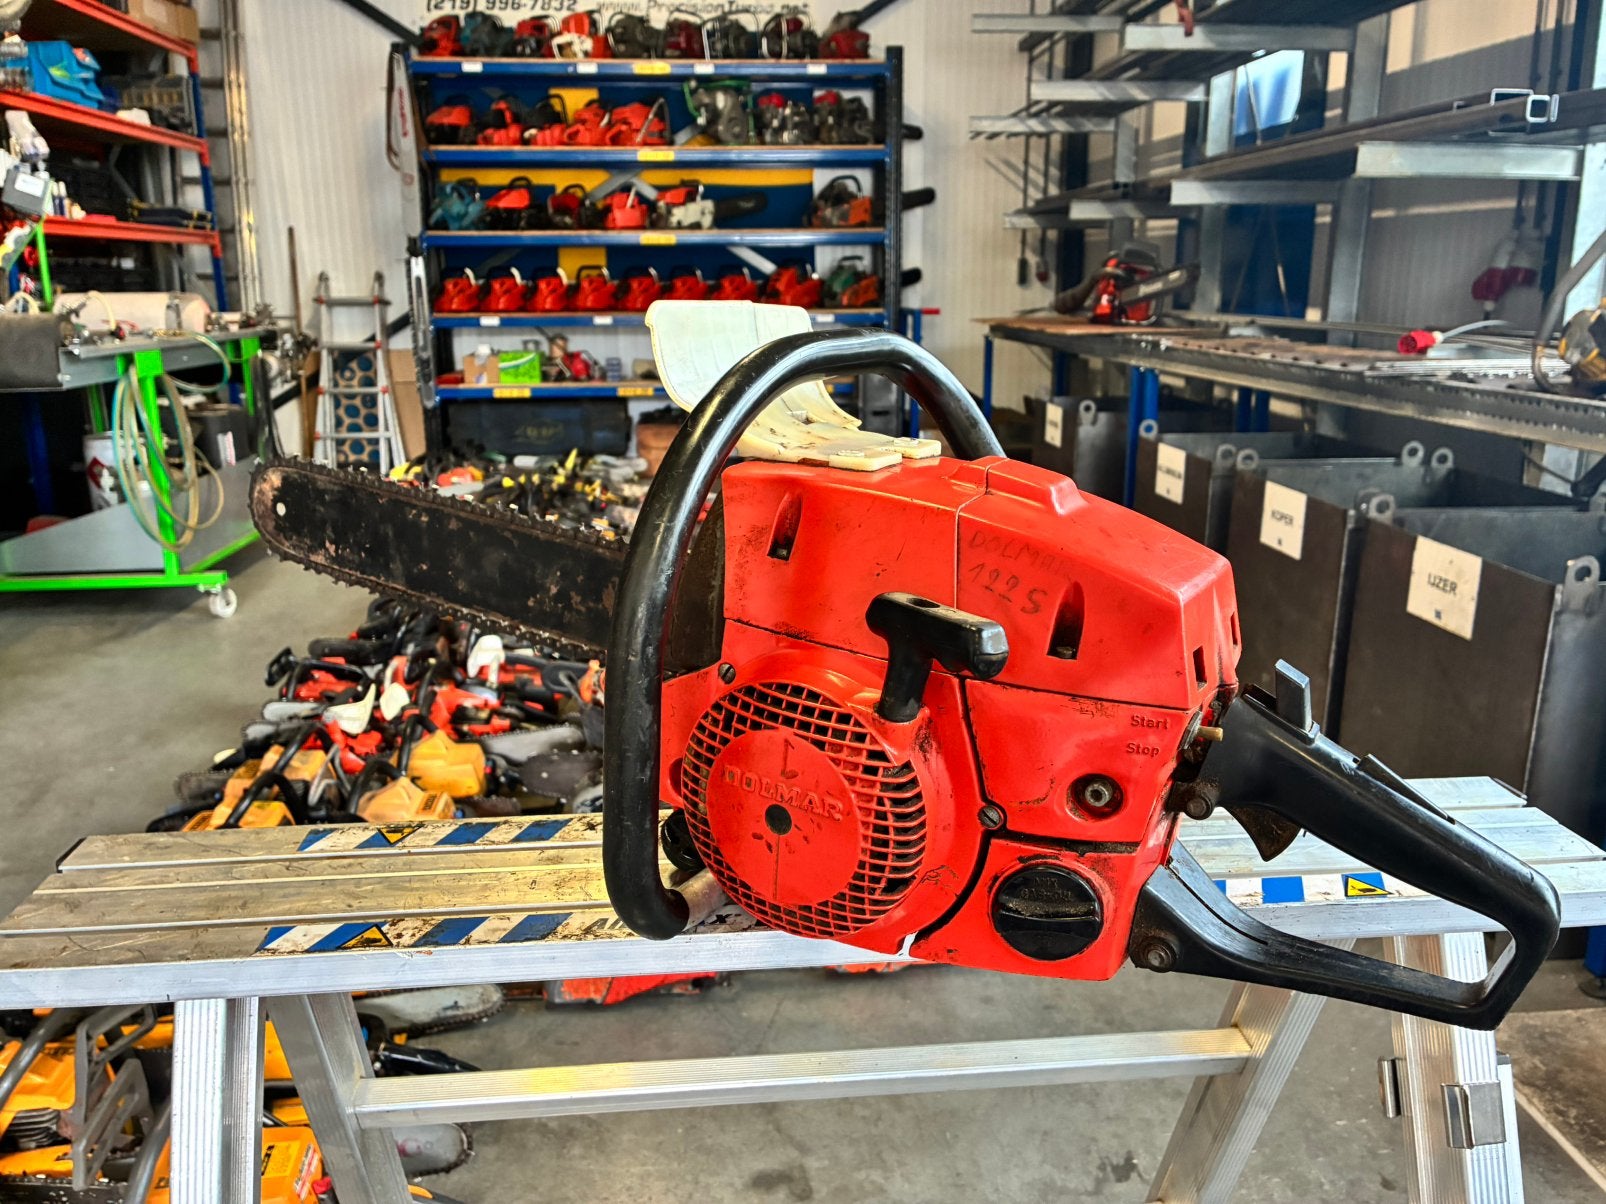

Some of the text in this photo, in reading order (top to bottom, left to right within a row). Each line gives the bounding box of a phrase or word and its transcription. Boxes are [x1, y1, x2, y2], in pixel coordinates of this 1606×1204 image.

[1130, 714, 1168, 730] Start
[1126, 742, 1160, 758] Stop
[723, 764, 844, 821] DOLMAR
